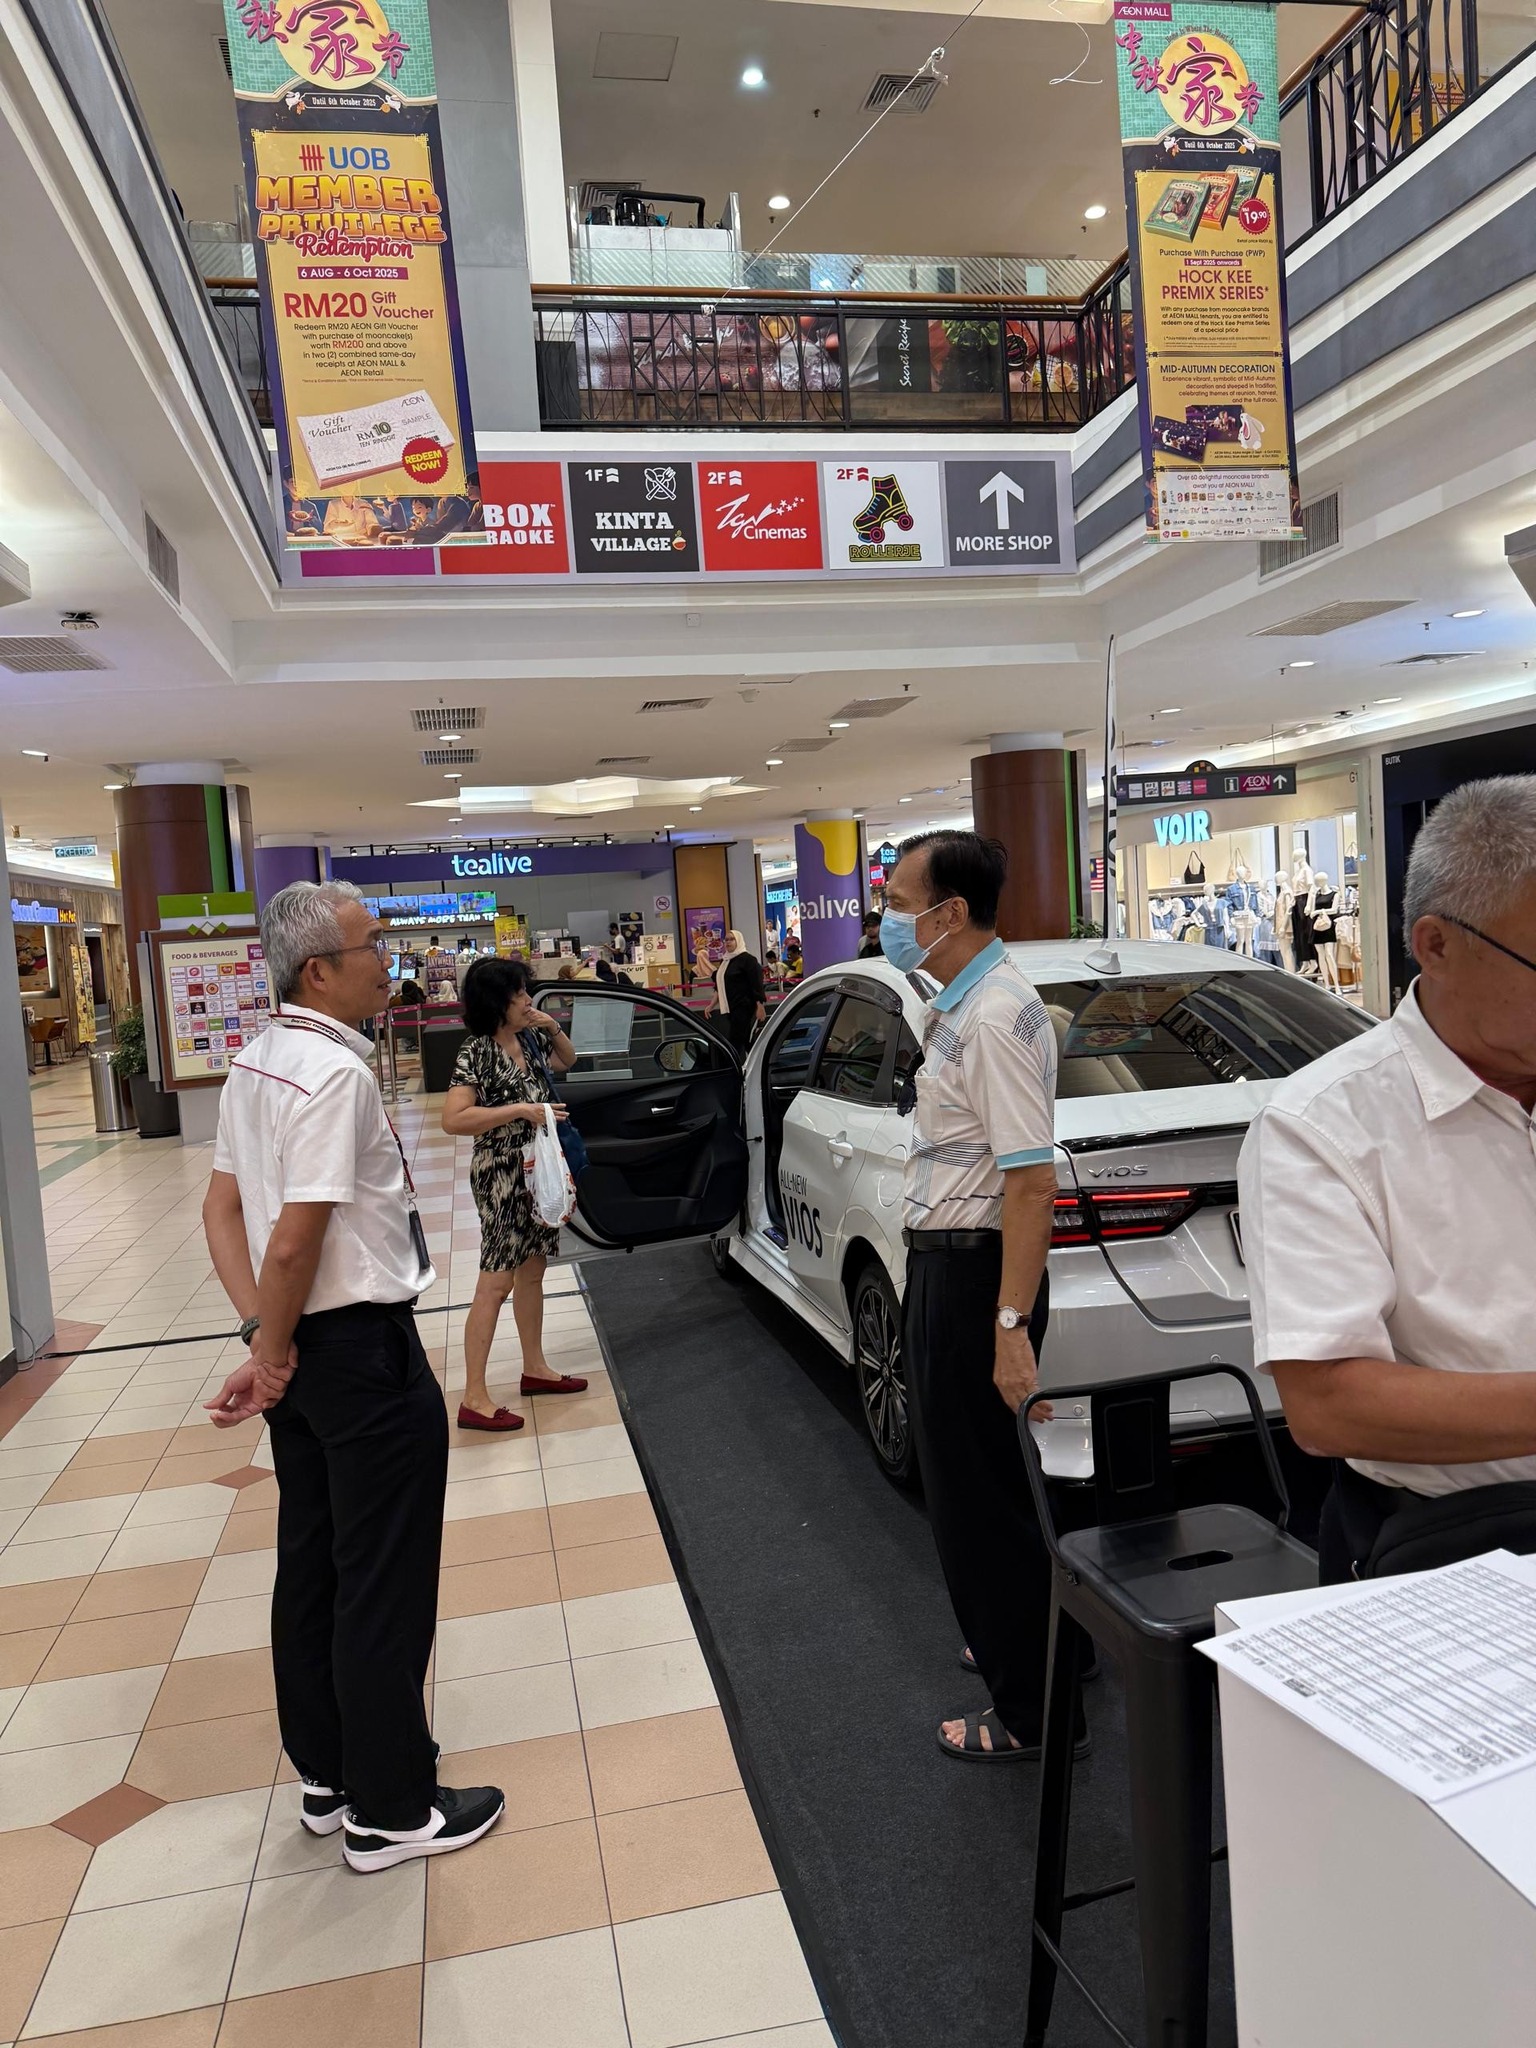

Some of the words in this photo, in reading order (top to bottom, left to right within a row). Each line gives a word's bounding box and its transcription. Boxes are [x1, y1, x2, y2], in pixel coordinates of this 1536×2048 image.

[1145, 6, 1169, 17] MALL
[312, 97, 327, 106] Until
[328, 97, 339, 106] 6th
[339, 97, 361, 107] October
[362, 98, 376, 107] 2025
[1184, 141, 1196, 149] Until
[1206, 141, 1223, 149] October
[329, 146, 390, 171] UOB
[256, 175, 441, 214] MEMBER
[1244, 211, 1267, 224] 19.90
[257, 212, 447, 244] PRIVILEGE
[296, 228, 414, 262] Redemption
[301, 268, 307, 277] 6
[310, 268, 334, 277] AUG
[344, 268, 350, 277] 6
[352, 268, 372, 277] Oct
[375, 268, 398, 278] 2025
[1179, 270, 1222, 283] HOCK
[1227, 270, 1252, 283] KEE
[371, 291, 397, 304] Gift
[1162, 286, 1215, 300] PREMIX
[284, 292, 367, 318] RM20
[372, 306, 434, 319] Voucher
[327, 351, 337, 359] (2)
[316, 360, 345, 368] receipts
[1160, 365, 1216, 373] MID-AUTUMN
[1220, 365, 1275, 373] DECORATION
[323, 416, 345, 428] Gift
[402, 413, 432, 425] SAMPLE
[308, 424, 352, 438] Voucher
[405, 449, 442, 464] REDEEM
[412, 460, 441, 473] NOW!
[585, 469, 603, 483] 1F
[708, 472, 726, 485] 2F
[837, 469, 854, 480] 2F
[483, 504, 553, 527] BOX
[595, 512, 674, 530] KINTA
[743, 525, 807, 540] Cinemas
[591, 537, 672, 552] VILLAGE
[956, 536, 1004, 551] MORE
[1008, 535, 1053, 550] SHOP
[1154, 810, 1212, 848] VOIR
[881, 847, 895, 855] tea
[451, 853, 532, 877] tealive
[390, 916, 425, 926] ALWAYS
[428, 914, 455, 923] MORE
[457, 913, 480, 922] THAN
[199, 950, 238, 958] BEVERAGES
[1087, 1164, 1149, 1178] VIOS
[780, 1169, 807, 1196] ALL-NEW
[782, 1192, 822, 1258] VIOS
